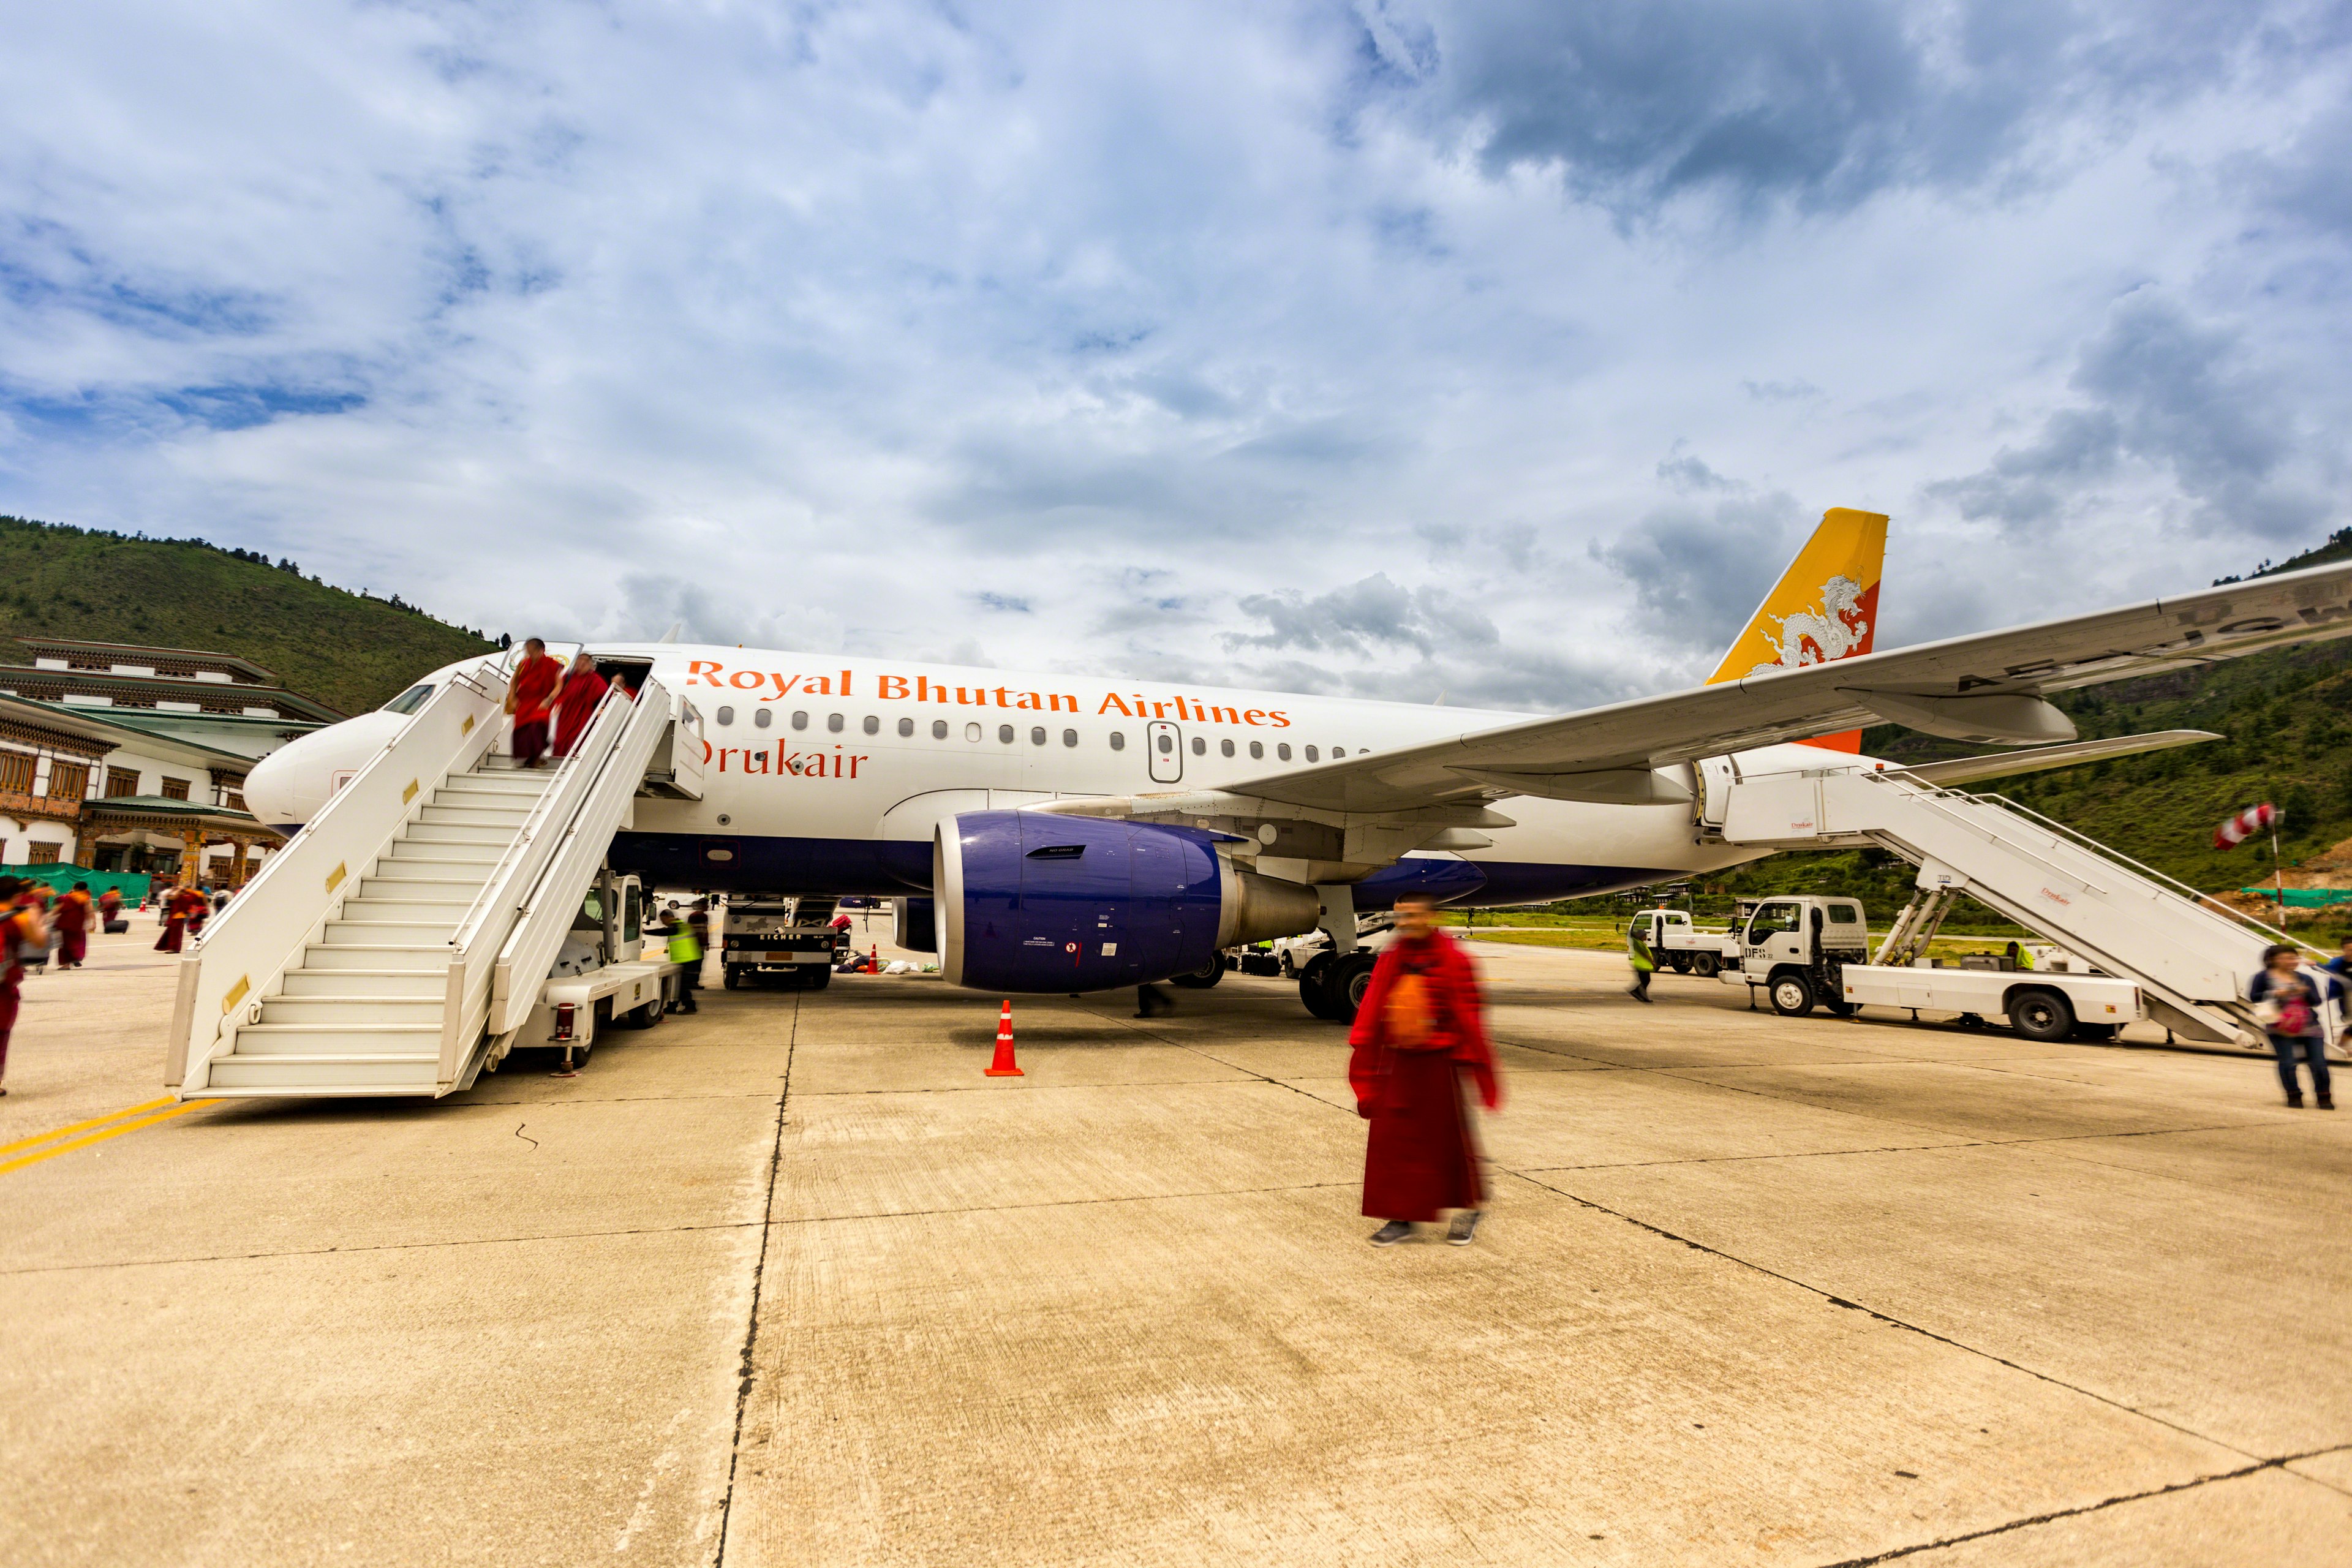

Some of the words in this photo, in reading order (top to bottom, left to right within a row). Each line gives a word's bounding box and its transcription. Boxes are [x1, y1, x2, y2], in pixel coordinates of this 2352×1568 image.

[686, 661, 854, 701] Royal
[876, 675, 1081, 714] Bhutan
[1098, 693, 1291, 728] Airlines
[1744, 948, 1766, 959] DFS
